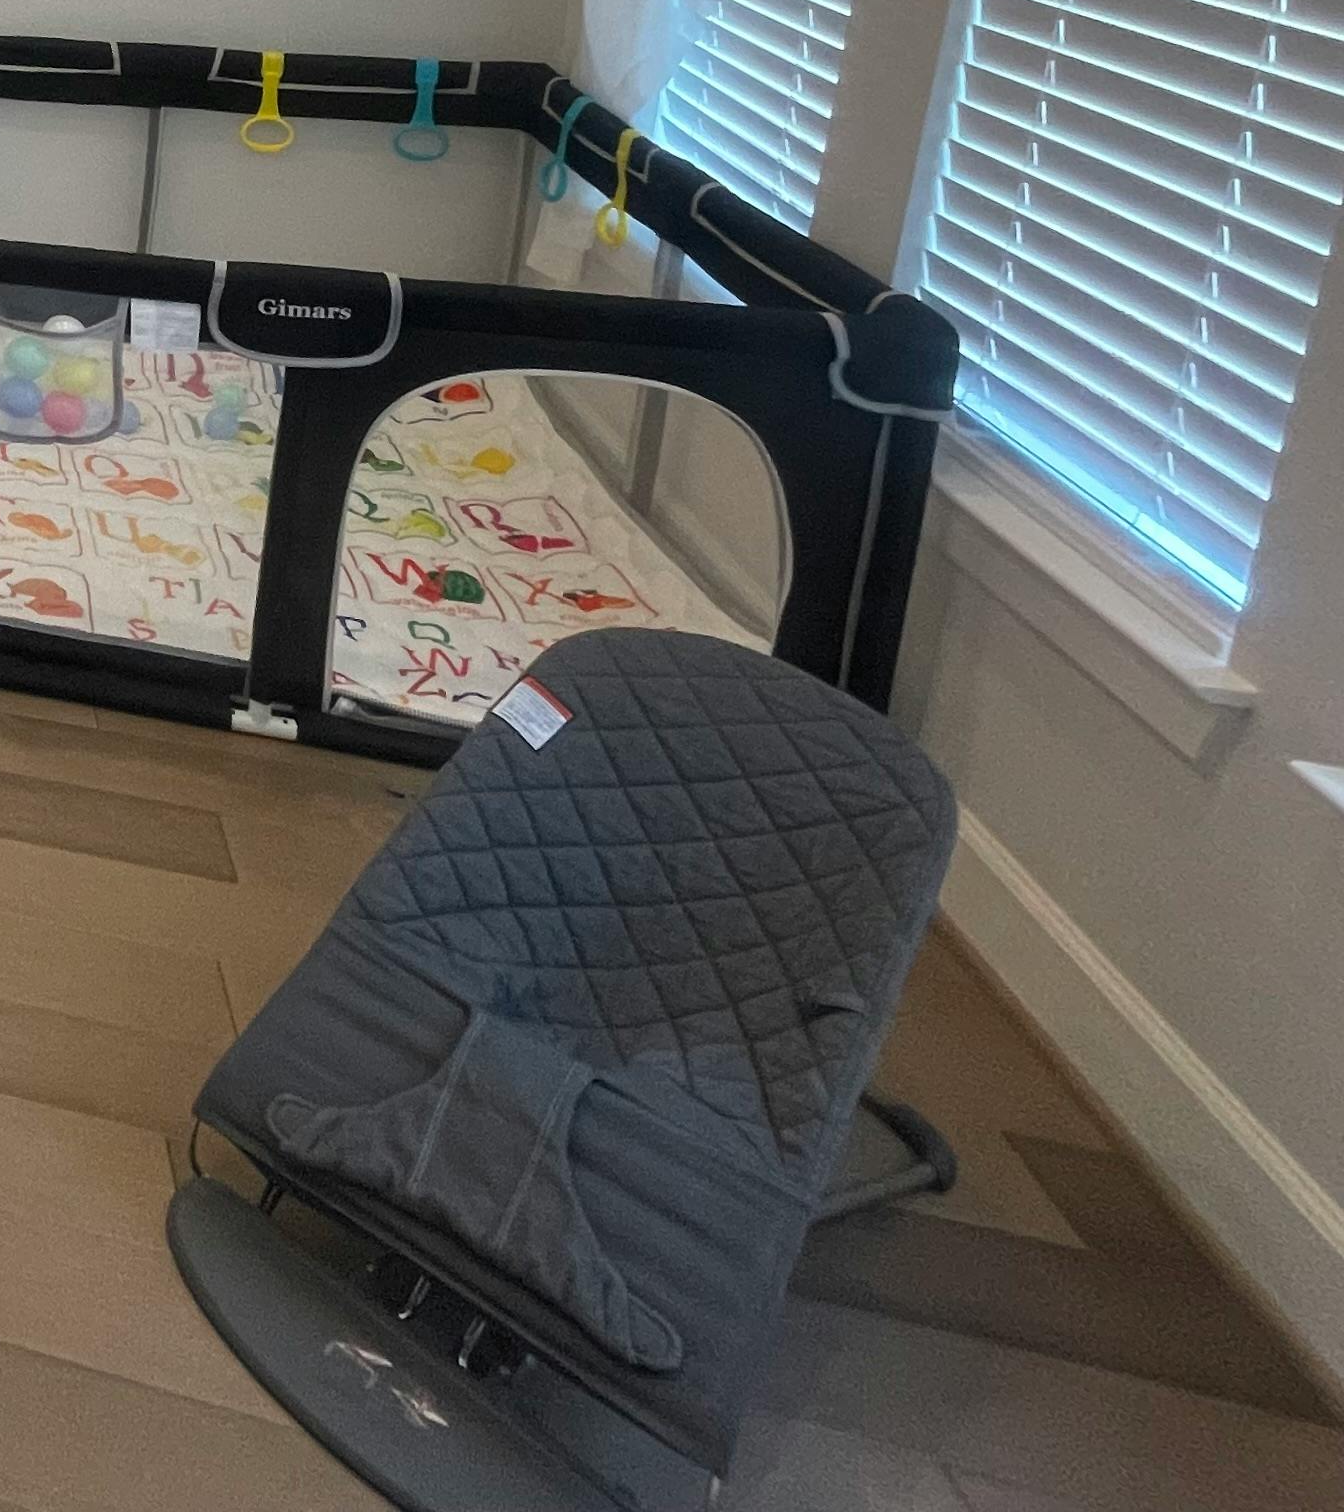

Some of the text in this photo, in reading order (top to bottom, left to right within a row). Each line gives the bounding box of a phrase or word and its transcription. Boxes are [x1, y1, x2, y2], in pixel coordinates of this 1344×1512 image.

[257, 298, 352, 320] Gimars
[148, 576, 185, 599] T
[204, 598, 245, 620] A
